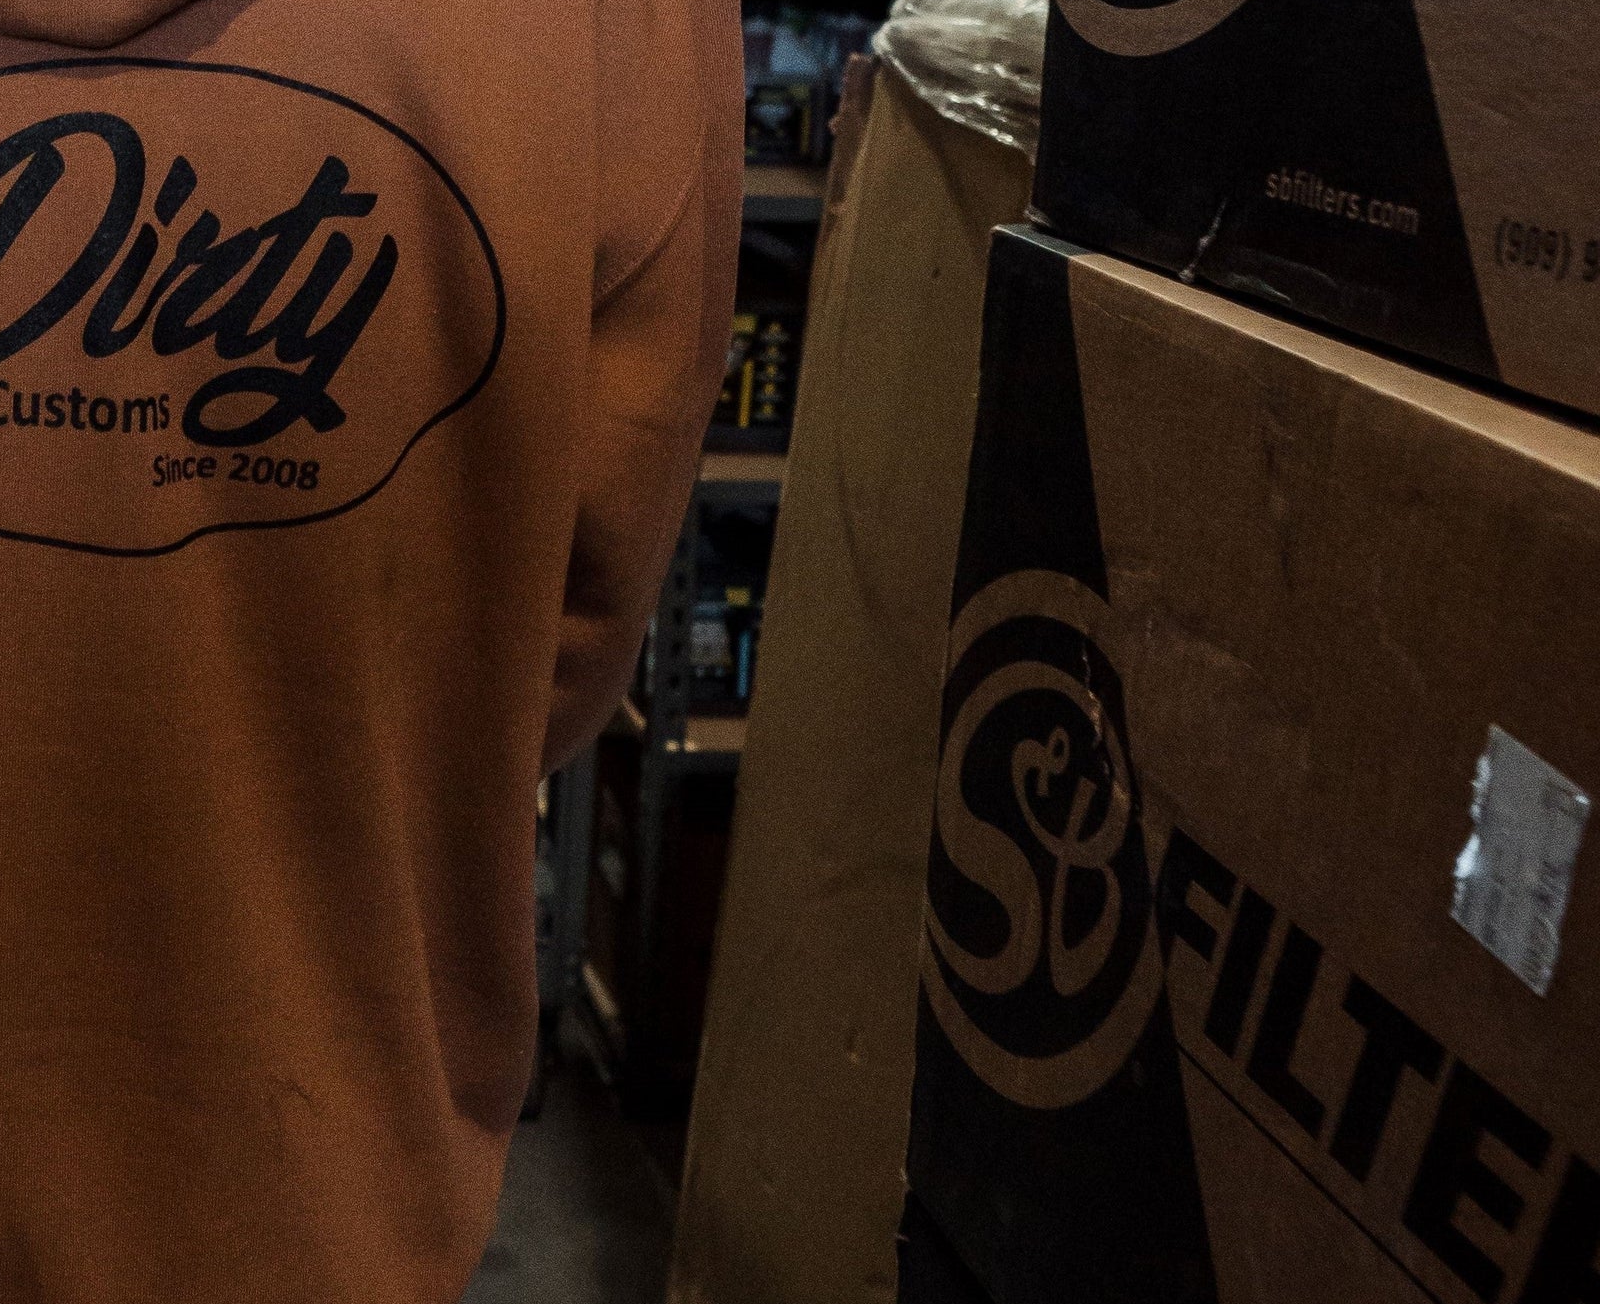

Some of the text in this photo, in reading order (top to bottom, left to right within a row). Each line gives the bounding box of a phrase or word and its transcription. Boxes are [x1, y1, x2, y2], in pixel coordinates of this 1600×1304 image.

[1264, 167, 1420, 236] sbfilters.com
[153, 453, 320, 490] Since 2008
